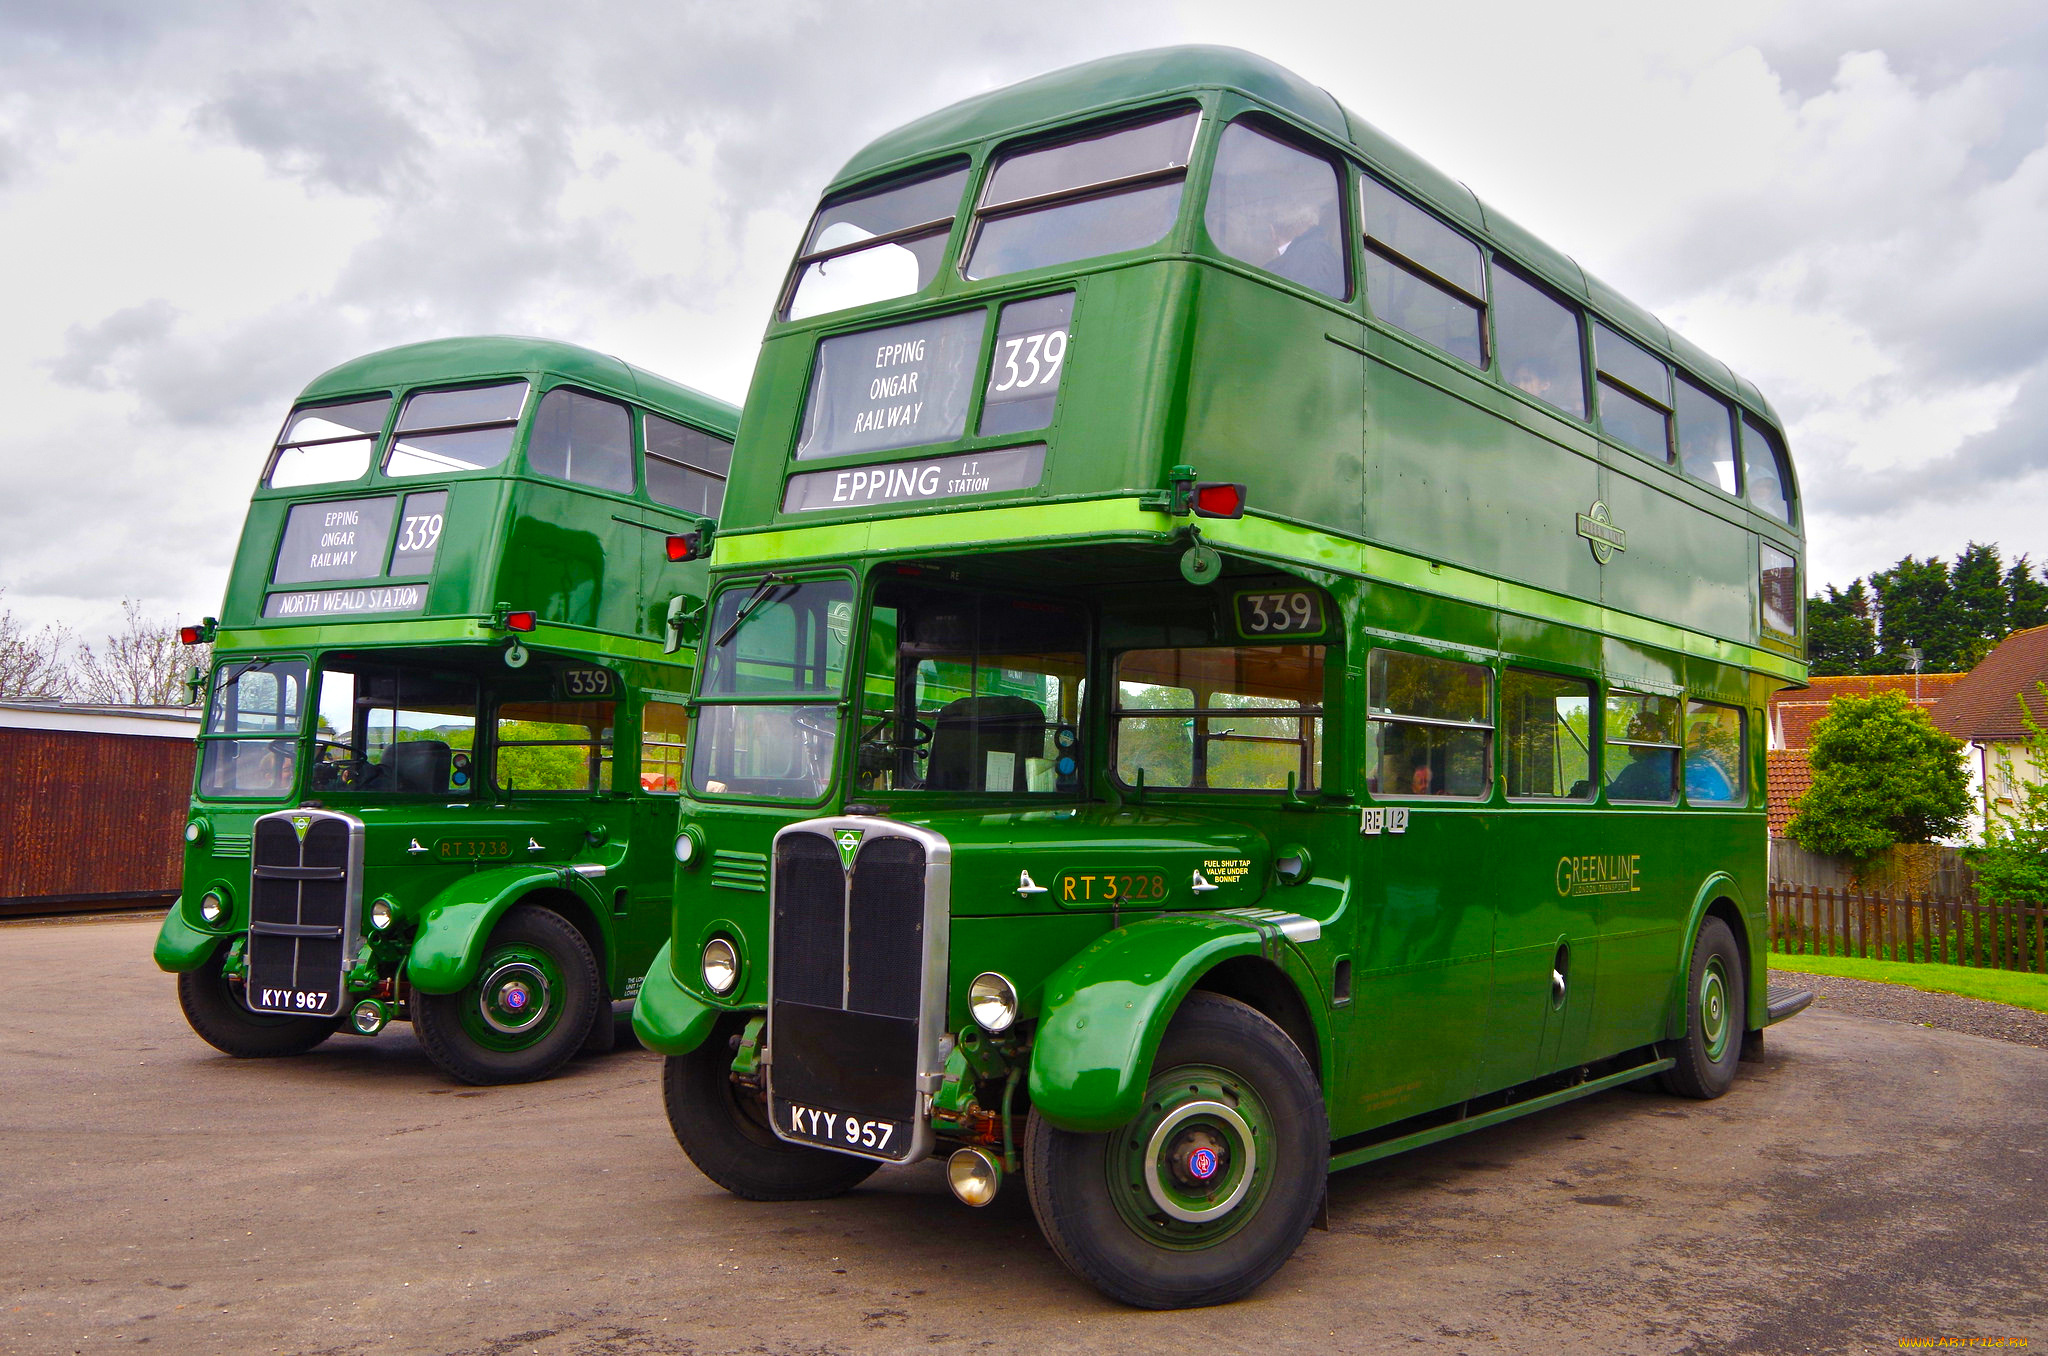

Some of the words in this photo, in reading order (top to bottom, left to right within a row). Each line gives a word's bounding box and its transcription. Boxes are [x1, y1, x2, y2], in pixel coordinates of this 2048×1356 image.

[876, 339, 926, 369] EPPING
[995, 330, 1067, 392] 339
[870, 371, 918, 401] ONGAR
[854, 402, 923, 434] RAILWAY
[832, 466, 941, 502] EPPING
[947, 477, 989, 494] STATION
[325, 510, 359, 527] EPPING
[398, 513, 444, 551] 339
[321, 531, 355, 547] ONGAR
[310, 551, 358, 568] RAILWAY
[279, 591, 319, 614] NORTH
[322, 589, 365, 611] WEALD
[368, 587, 418, 609] STATION
[1247, 592, 1312, 632] 339
[568, 670, 608, 694] 339
[1365, 811, 1381, 830] RE
[441, 841, 464, 858] RT
[467, 840, 508, 857] 3238
[1063, 876, 1096, 901] RT
[1103, 875, 1164, 900] 3228
[1556, 855, 1607, 897] GREEN
[1610, 854, 1641, 892] LINE
[261, 989, 293, 1009] KYY
[295, 991, 328, 1011] 967
[791, 1105, 837, 1140] KYY
[845, 1117, 894, 1151] 957
